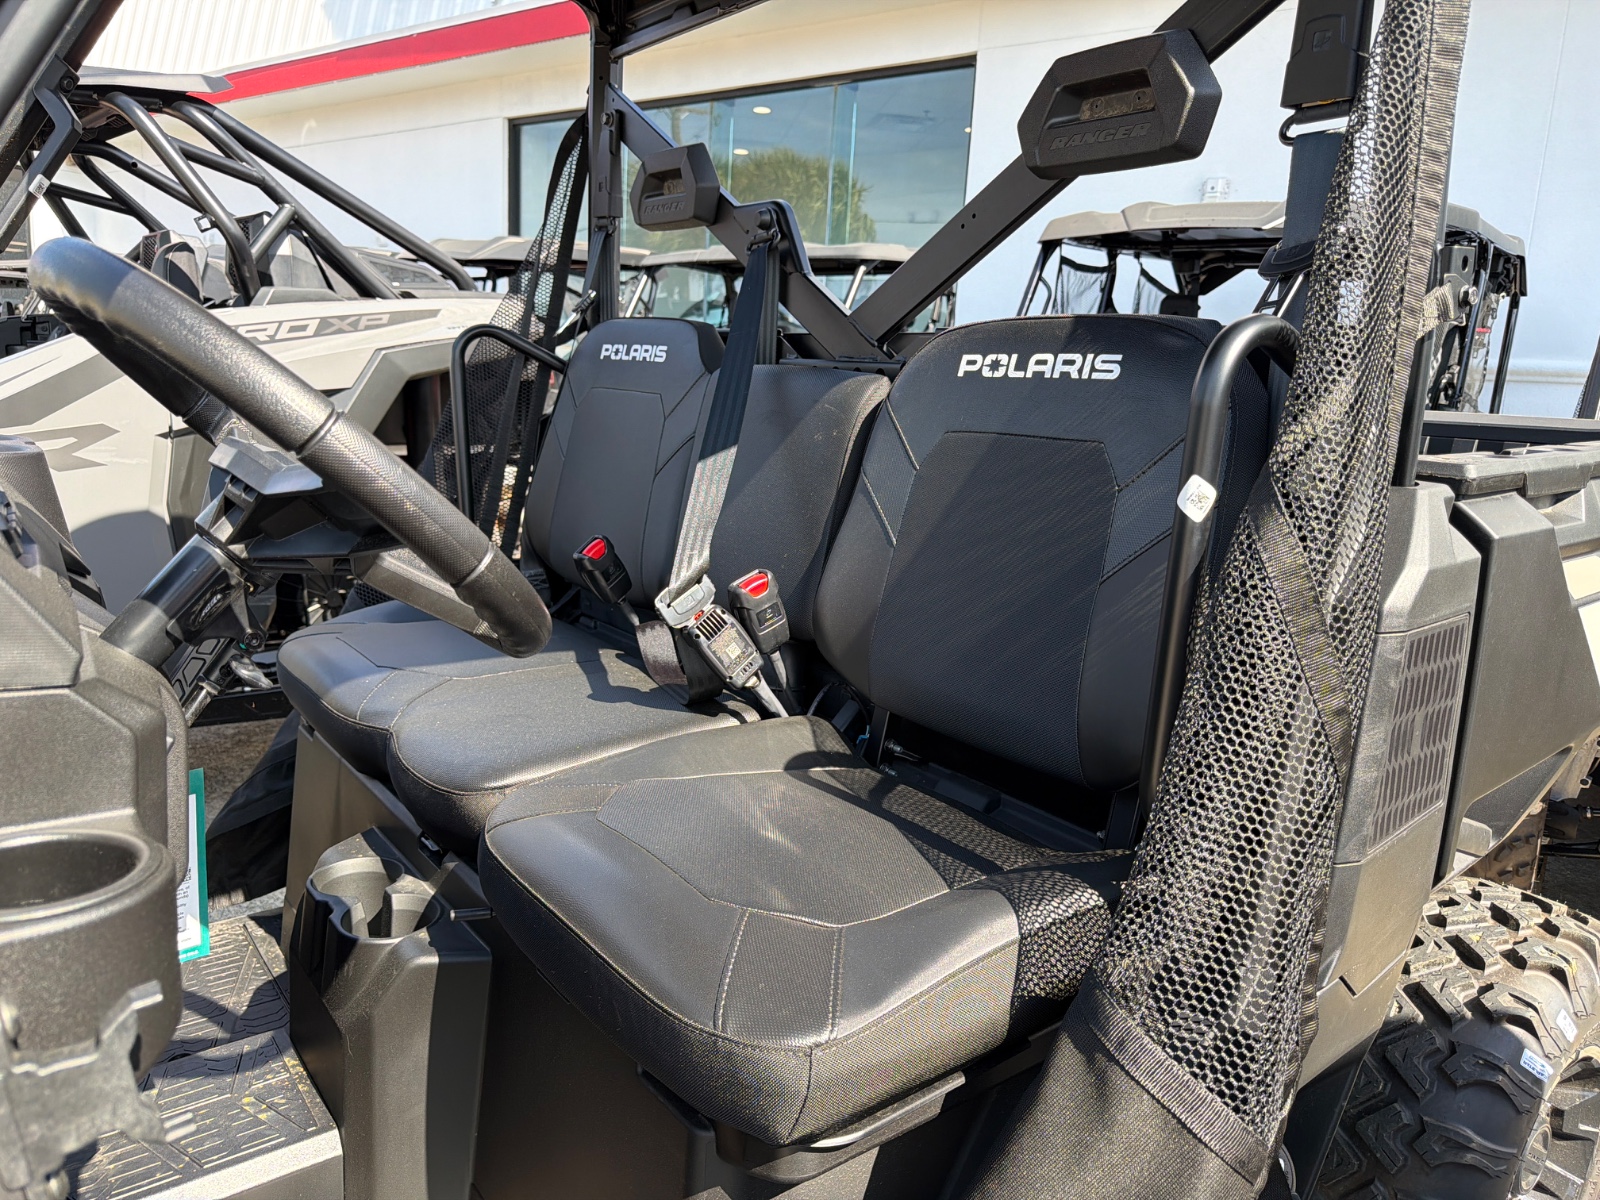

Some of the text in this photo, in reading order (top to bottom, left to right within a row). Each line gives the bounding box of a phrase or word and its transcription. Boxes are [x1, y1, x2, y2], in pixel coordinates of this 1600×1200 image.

[1050, 122, 1151, 151] RANGER
[644, 201, 687, 215] RANGER
[235, 314, 390, 342] RO XP
[600, 343, 668, 363] POLARIS
[957, 353, 1123, 380] POLARIS
